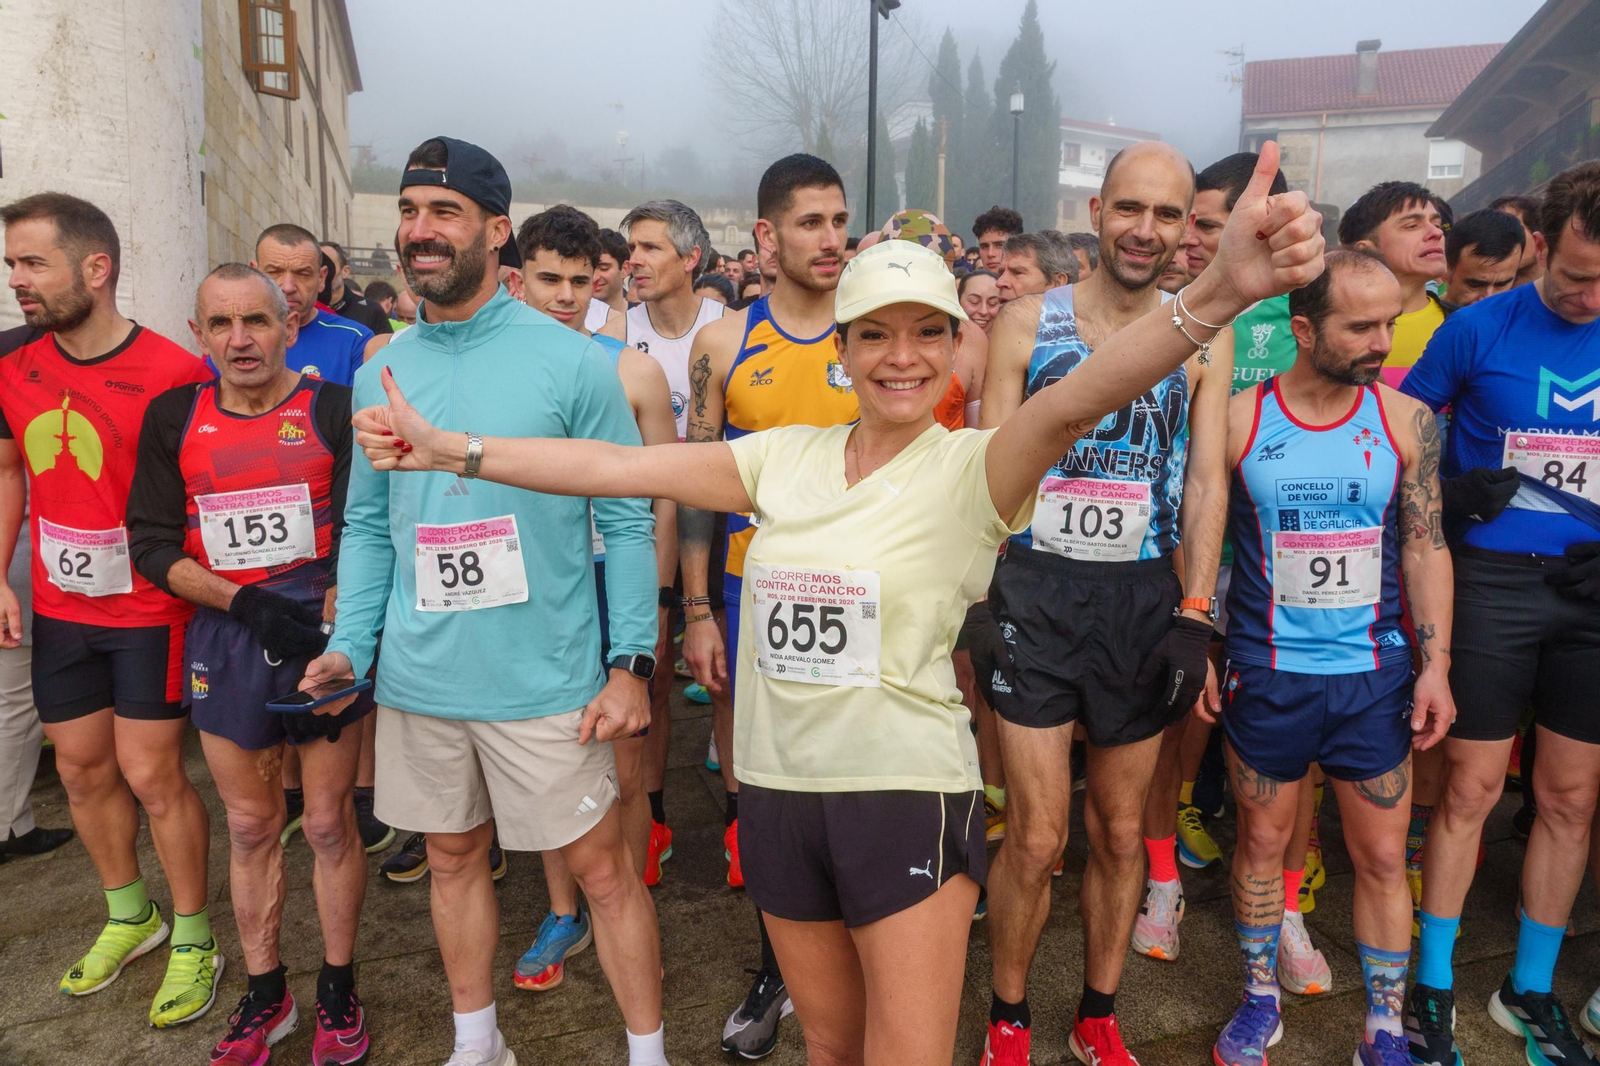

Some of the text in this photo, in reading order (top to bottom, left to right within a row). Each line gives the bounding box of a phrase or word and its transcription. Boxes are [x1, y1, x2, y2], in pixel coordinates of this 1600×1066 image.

[750, 378, 773, 387] ZICO
[1257, 453, 1285, 462] ZICO
[1542, 460, 1587, 492] 84
[1064, 480, 1128, 492] CORREMOS
[1281, 482, 1334, 492] CONCELLO
[217, 489, 282, 504] CORREMOS
[1046, 486, 1088, 496] CONTRA
[1100, 490, 1144, 500] CANCRO
[1288, 493, 1328, 502] DE VIGO
[206, 502, 244, 511] CONTRA
[258, 494, 301, 506] CANCRO
[246, 506, 273, 514] FEBREIRO
[1303, 510, 1340, 520] XUNTA
[1060, 502, 1124, 540] 103
[1304, 519, 1362, 530] DE GALICIA
[50, 526, 100, 540] CORREMOS
[224, 512, 288, 548] 153
[428, 523, 487, 536] CORREMOS
[77, 538, 118, 546] CANCRO
[418, 536, 447, 544] CONTRA
[460, 528, 508, 542] CANCRO
[1063, 538, 1086, 546] ALBERTO
[1300, 532, 1362, 541] CORREMOS
[448, 543, 478, 551] FEBREIRO
[1338, 538, 1375, 547] CANCRO
[225, 549, 251, 557] SATURNINO
[59, 548, 93, 578] 62
[437, 551, 484, 588] 58
[1310, 555, 1350, 588] 91
[771, 570, 842, 584] CORREMOS
[756, 579, 866, 596] CONTRA O CANCRO
[767, 592, 779, 600] MOS,
[797, 596, 827, 604] FEBREIRO
[768, 602, 847, 655] 655
[784, 654, 811, 663] AREVALO
